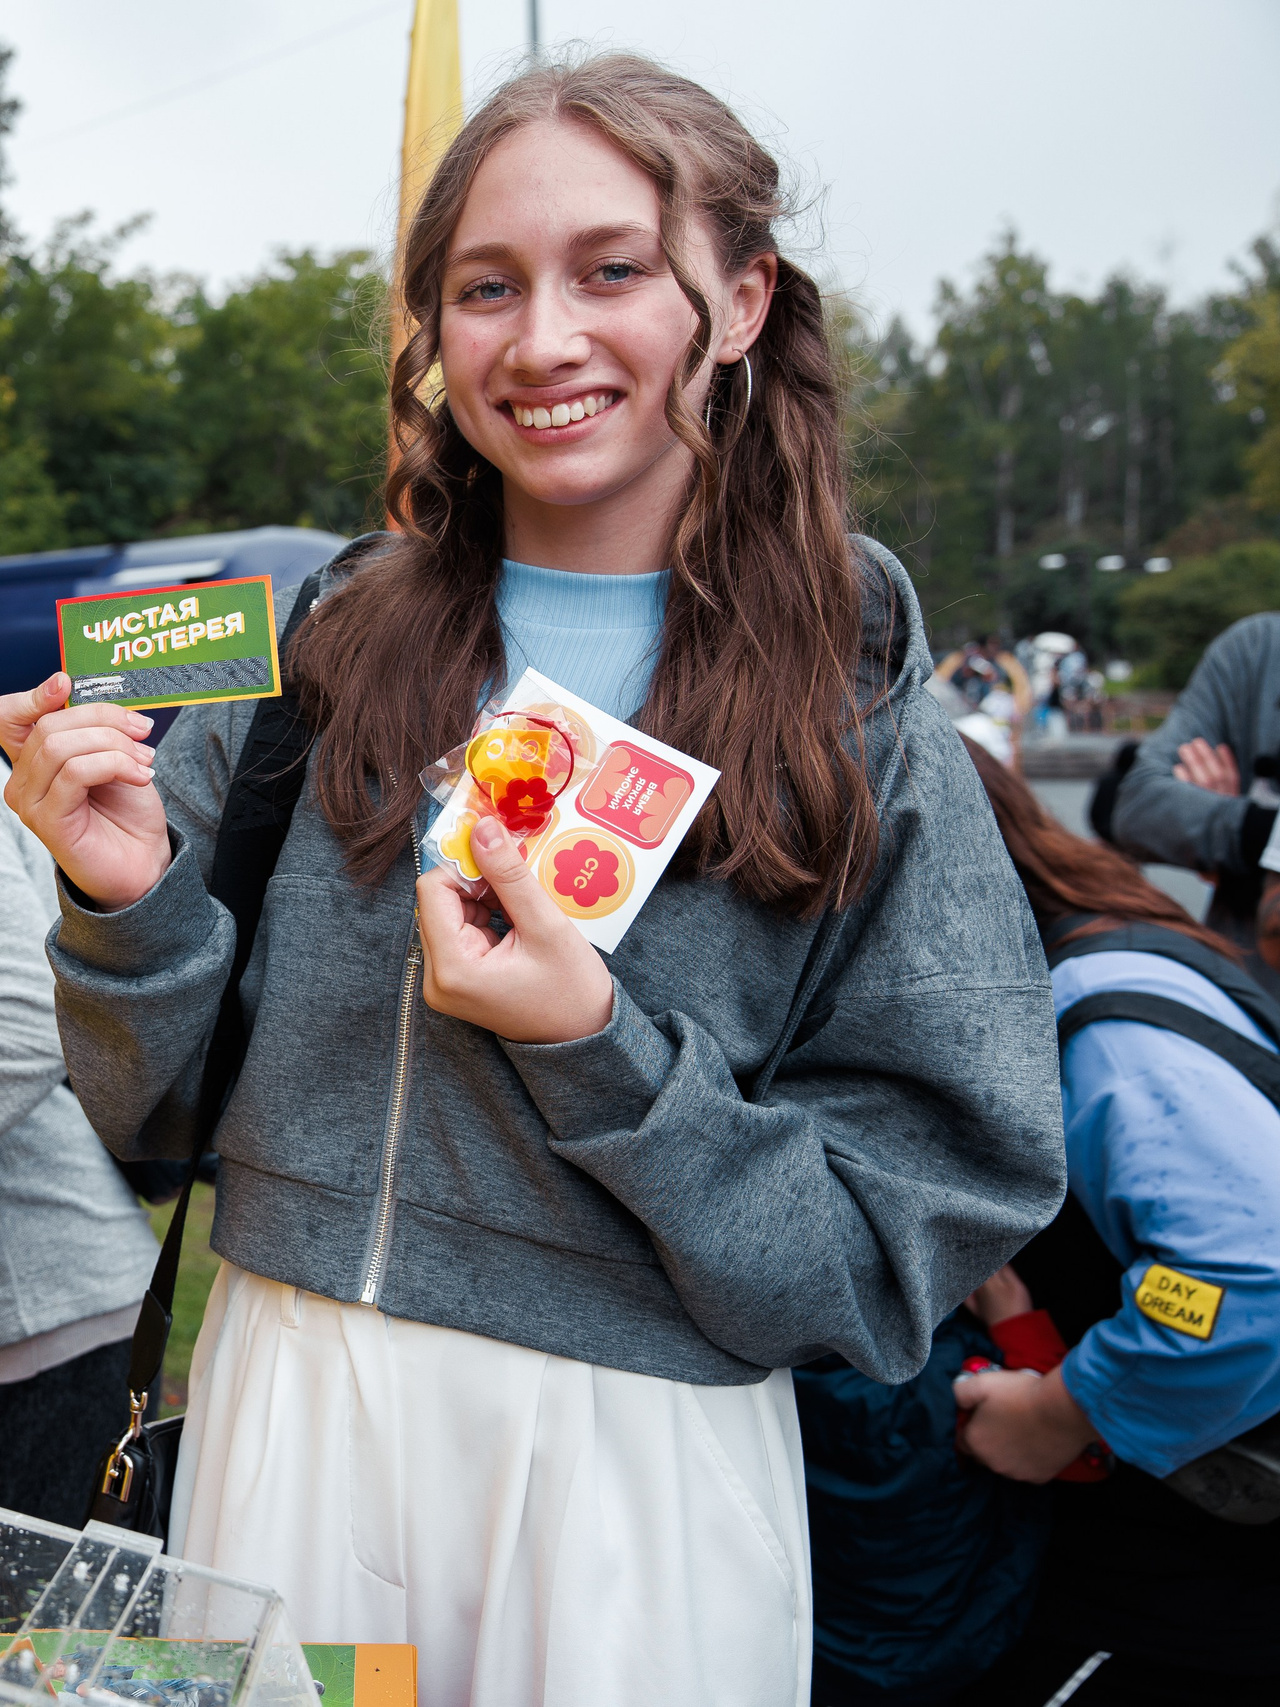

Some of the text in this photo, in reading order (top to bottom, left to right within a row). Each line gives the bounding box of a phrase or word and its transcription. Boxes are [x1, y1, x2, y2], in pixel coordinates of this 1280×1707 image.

[83, 597, 198, 643] ЧИСТАЯ
[111, 612, 244, 666] ЛОТЕРЕЯ
[608, 766, 639, 810] ЭМОЦИЙ
[621, 777, 646, 810] ЯРКИХ
[632, 781, 658, 816] ВРЕМЯ
[573, 857, 599, 890] СТС
[1158, 1276, 1198, 1299] DAY
[1140, 1292, 1205, 1326] DREAM
